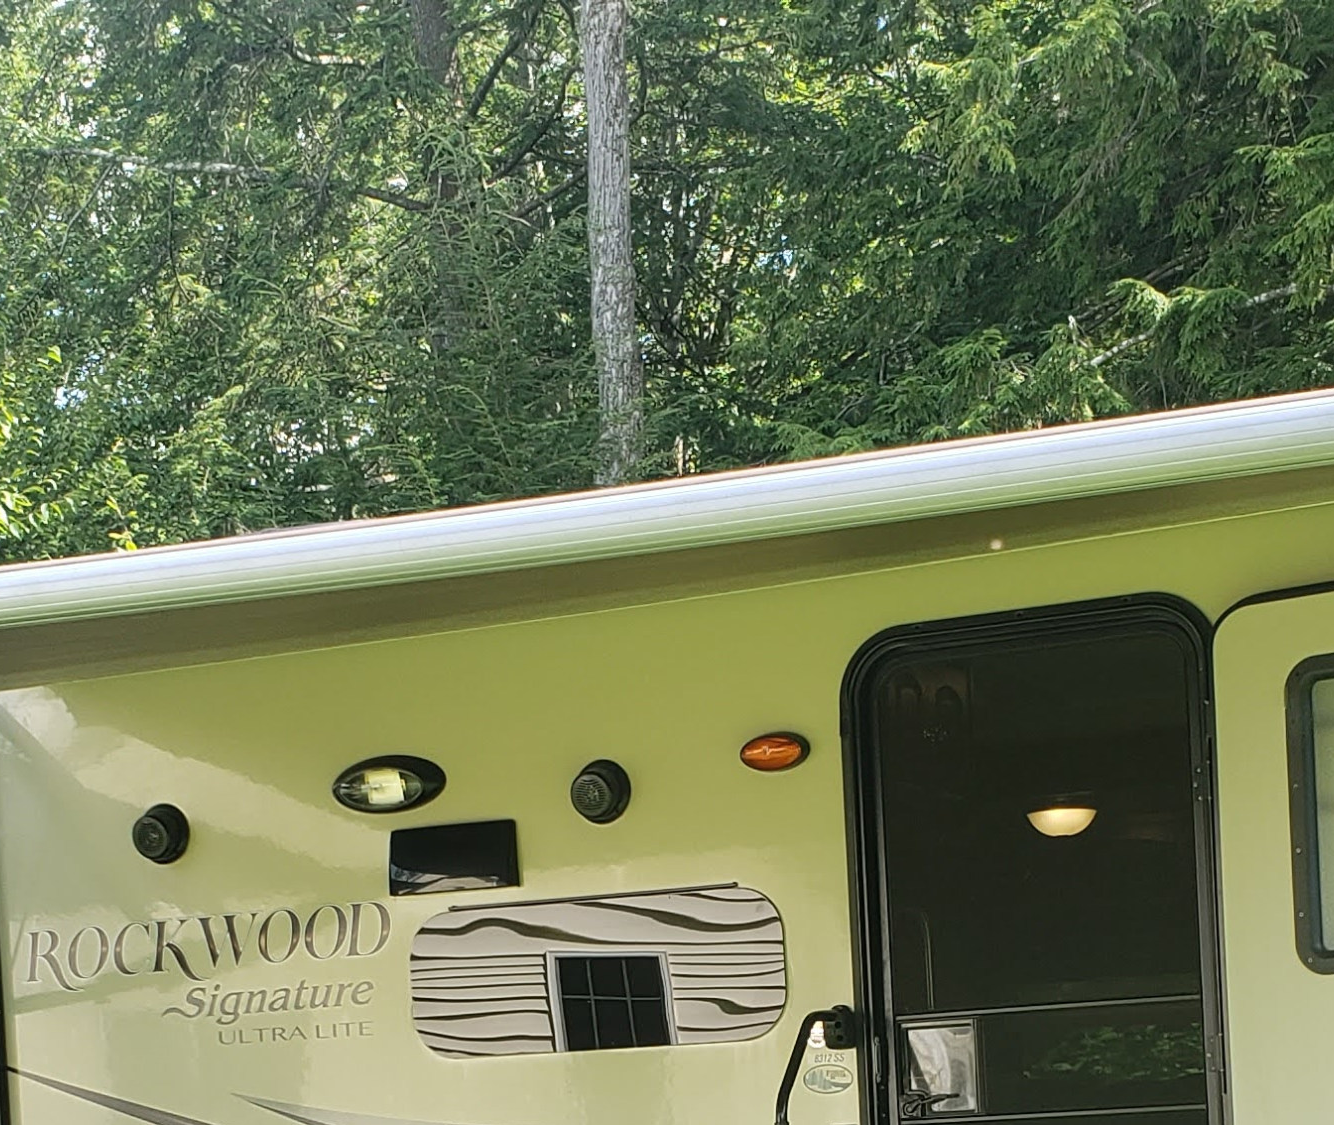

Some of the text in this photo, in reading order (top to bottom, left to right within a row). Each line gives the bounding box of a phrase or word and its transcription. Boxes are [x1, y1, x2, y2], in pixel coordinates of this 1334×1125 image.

[26, 901, 391, 991] ROCKWOOD
[162, 980, 374, 1025] Signature
[218, 1021, 374, 1045] ULTRA LITE
